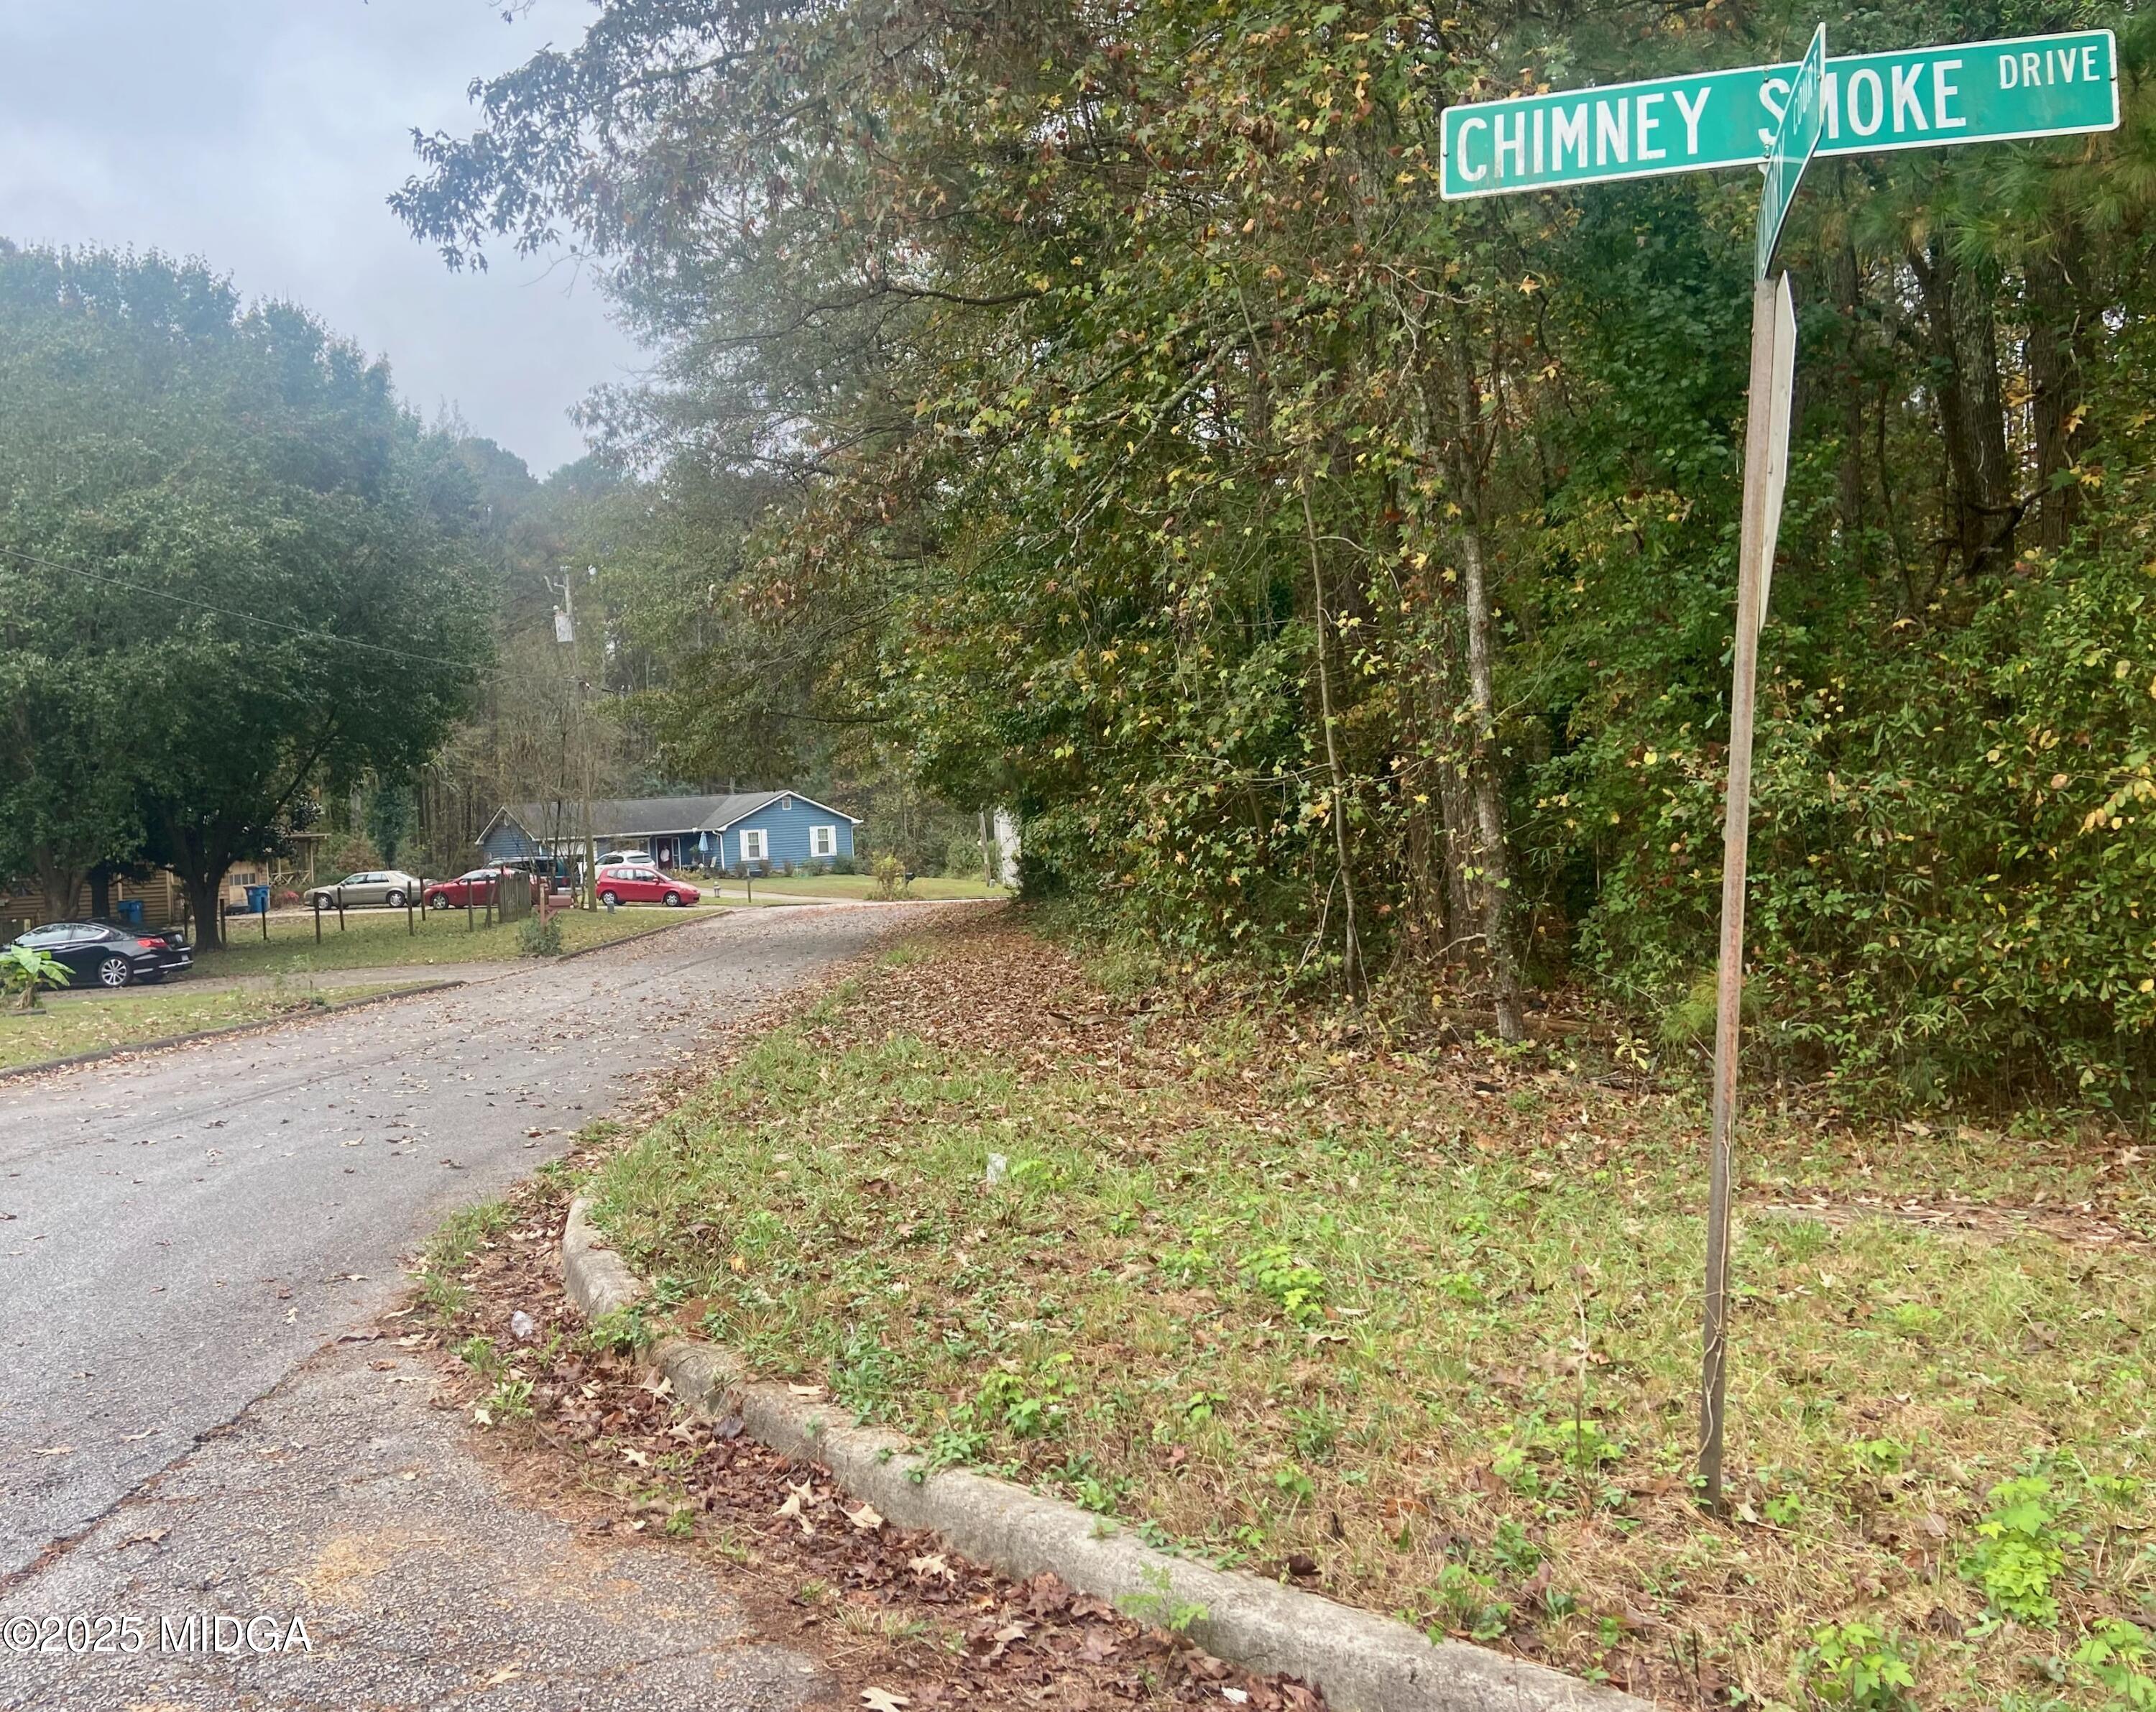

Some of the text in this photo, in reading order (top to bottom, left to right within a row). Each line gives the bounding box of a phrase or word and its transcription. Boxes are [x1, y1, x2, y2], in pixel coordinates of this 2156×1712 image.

[1457, 87, 1711, 182] CHIMNEY
[2000, 46, 2101, 89] DRIVE
[1792, 50, 1818, 136] COURT
